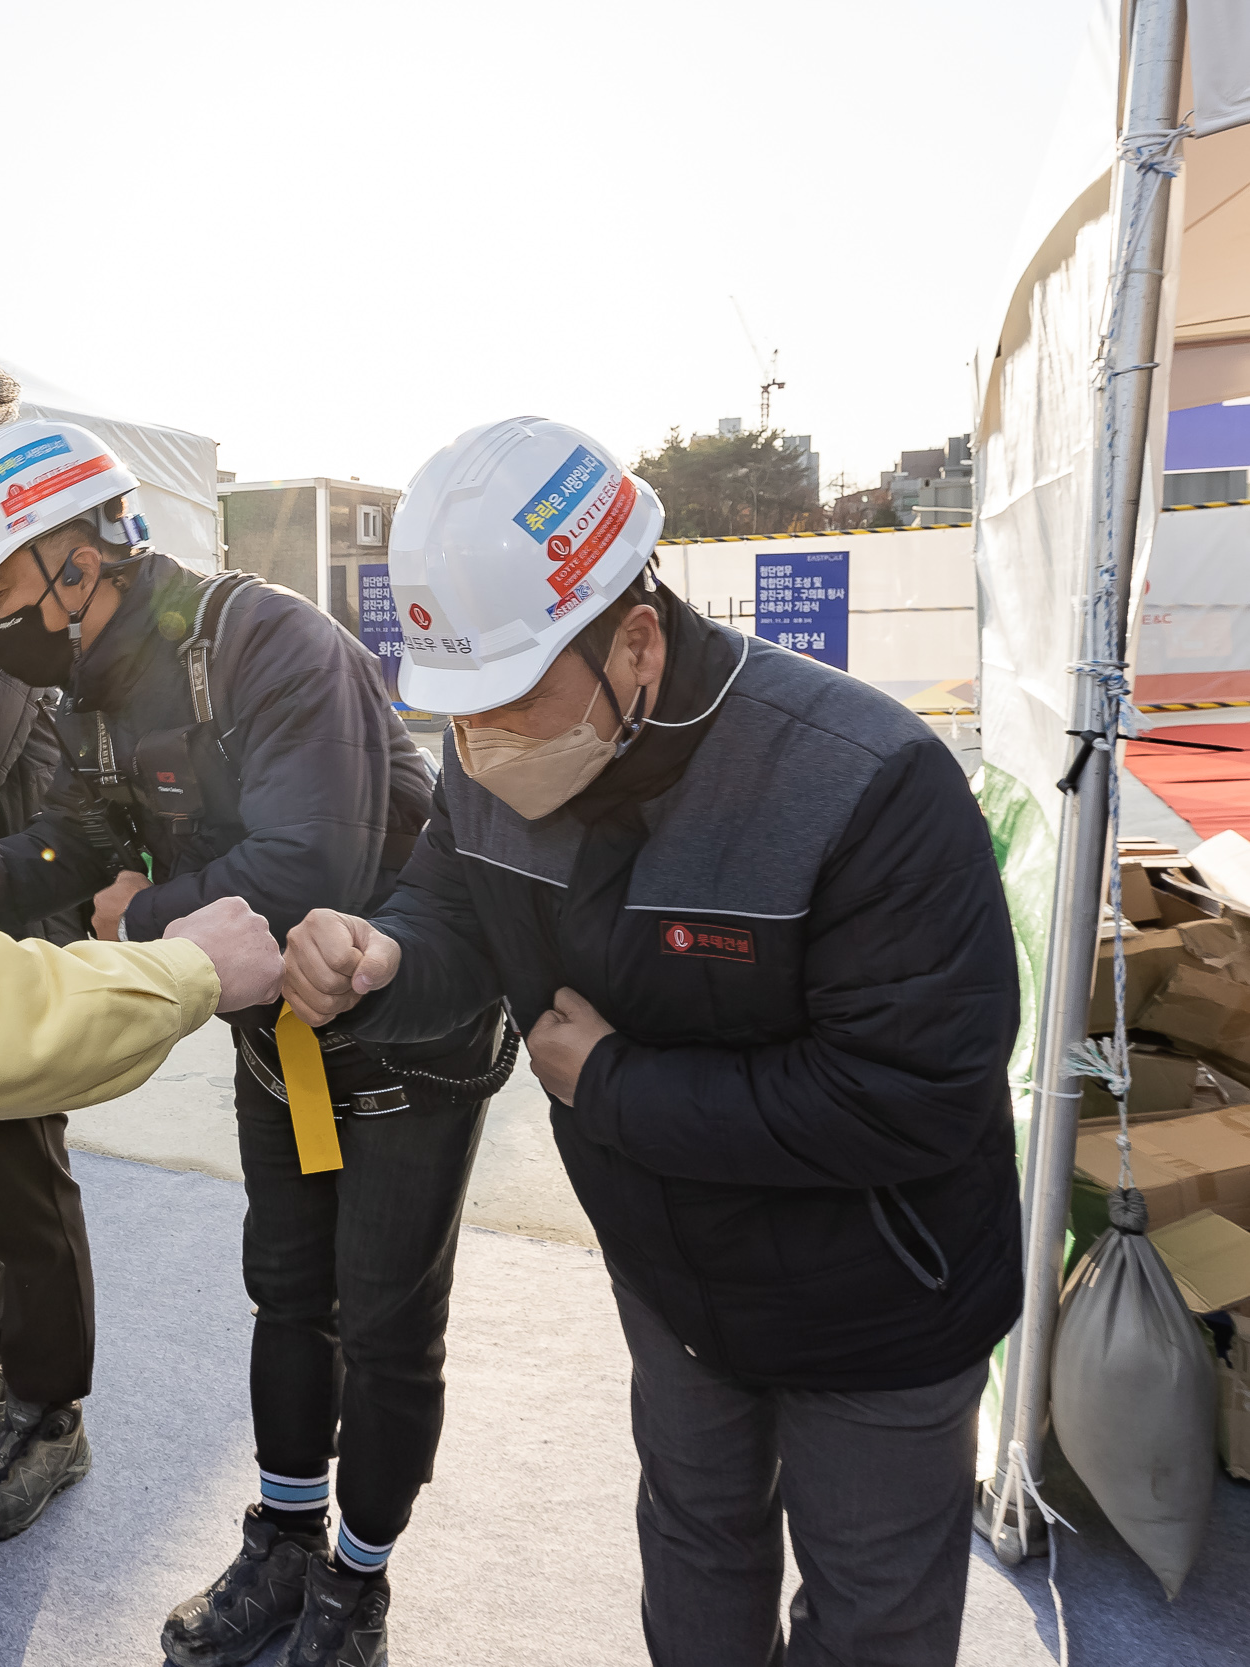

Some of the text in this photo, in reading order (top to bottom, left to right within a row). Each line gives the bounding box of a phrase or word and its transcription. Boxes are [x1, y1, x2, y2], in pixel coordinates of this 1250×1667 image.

[525, 493, 567, 532] 추락은
[564, 454, 600, 496] 사망입니다
[794, 577, 811, 588] 조성
[813, 576, 822, 588] 및
[759, 601, 820, 613] 신축공사 기공식
[362, 611, 390, 622] 신축공사
[441, 637, 473, 655] 팀장
[777, 632, 825, 650] 화장실
[696, 933, 749, 953] 롯데건설
